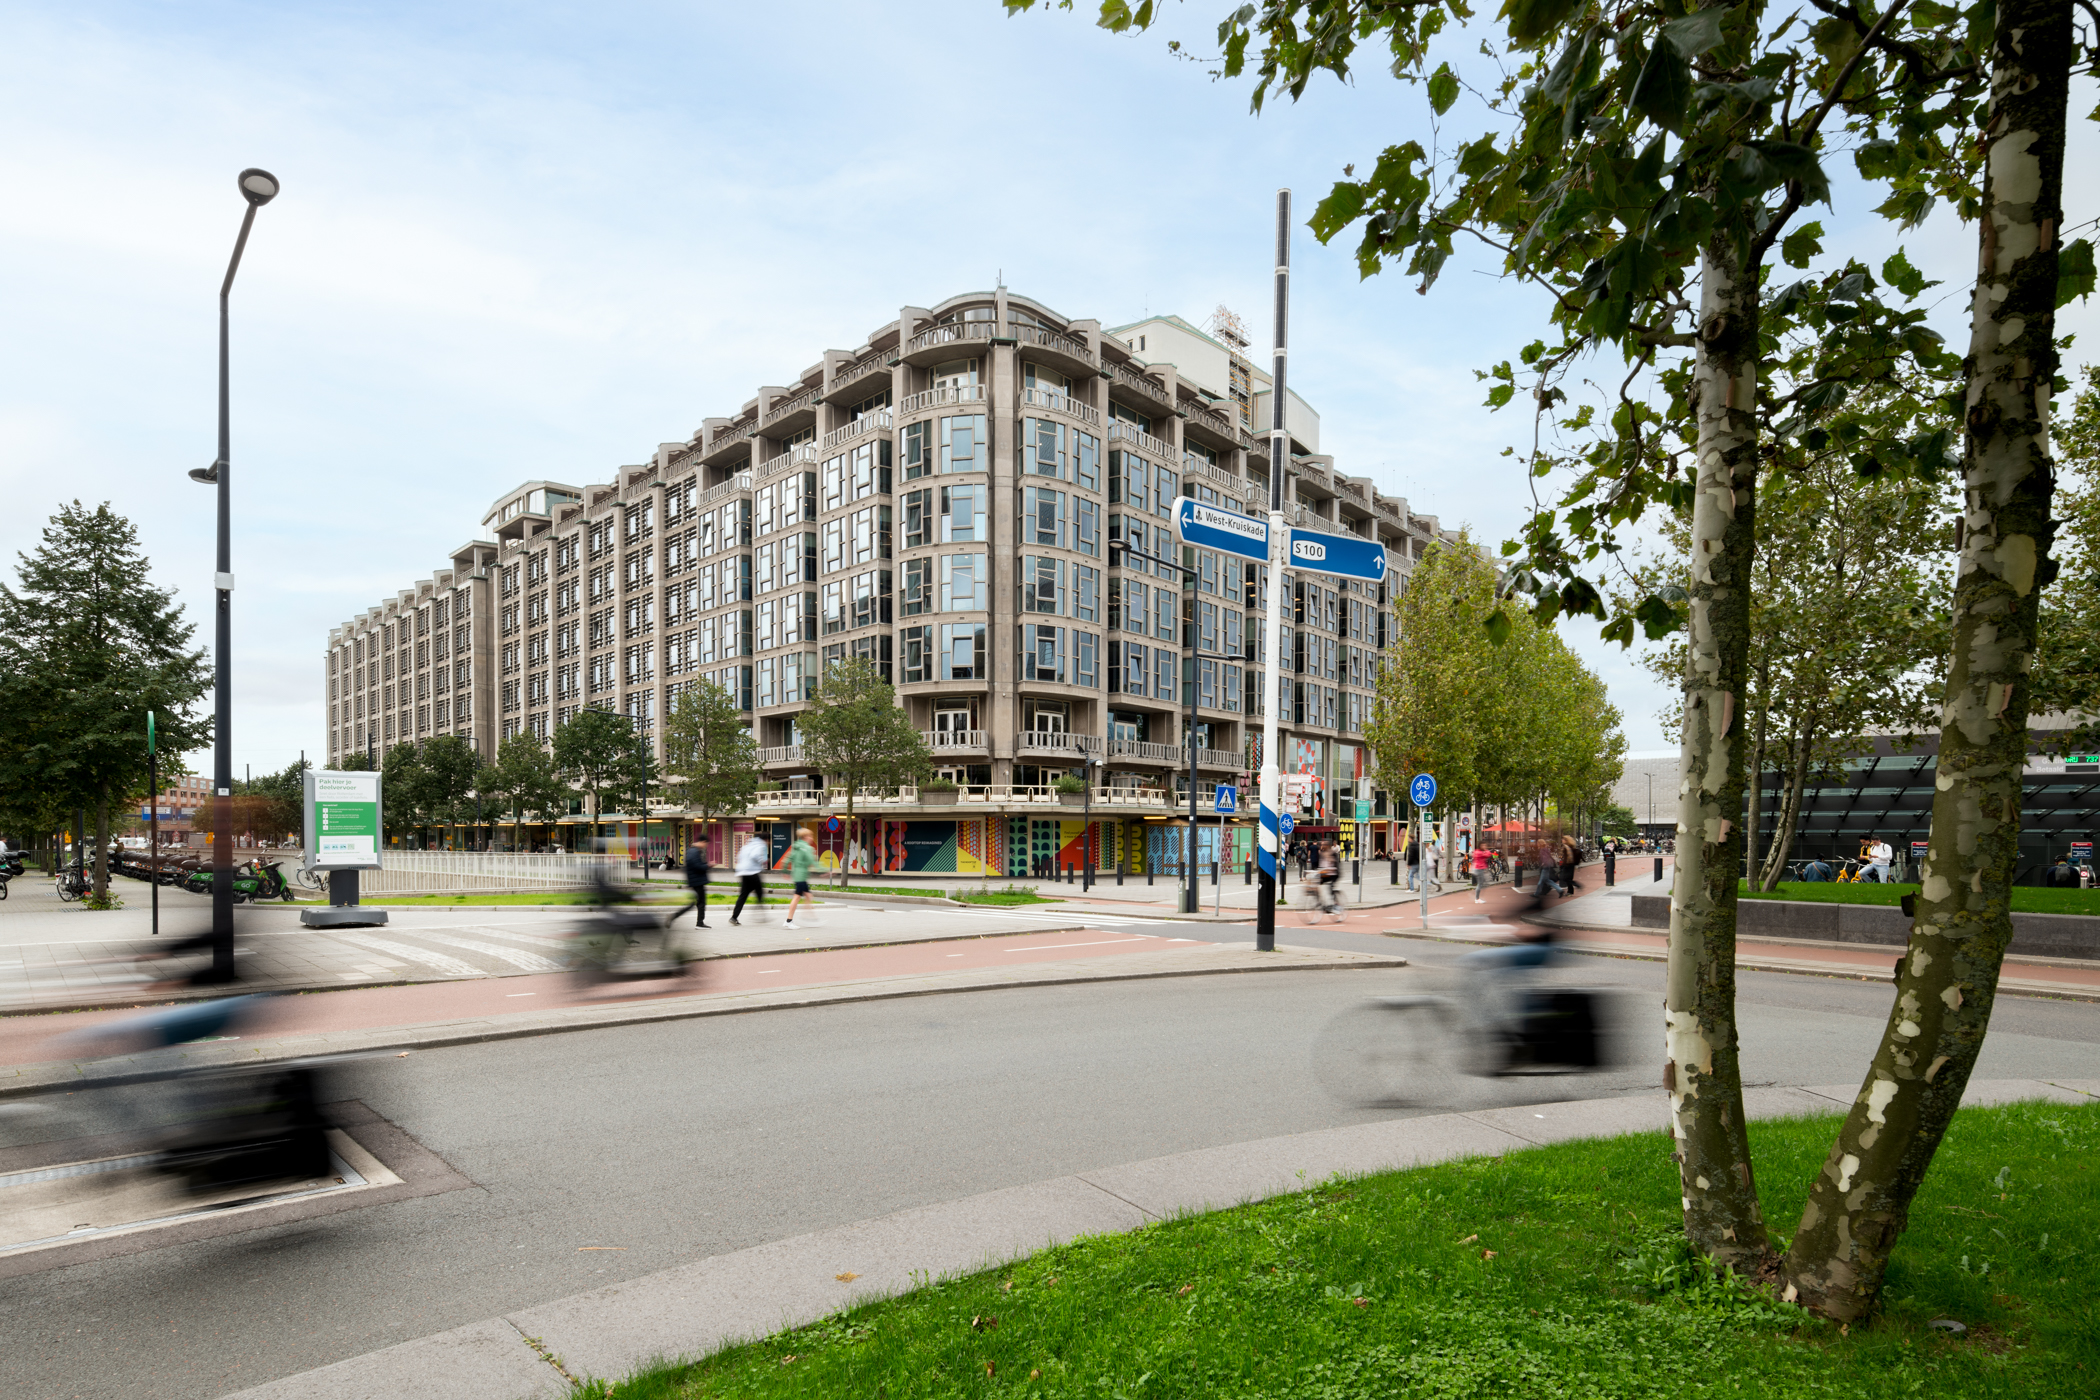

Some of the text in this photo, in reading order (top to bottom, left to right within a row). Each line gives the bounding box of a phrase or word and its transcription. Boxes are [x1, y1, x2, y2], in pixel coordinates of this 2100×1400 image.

[1206, 511, 1264, 537] West-Kruiskade
[1295, 543, 1323, 558] S 100
[2085, 755, 2099, 763] 737
